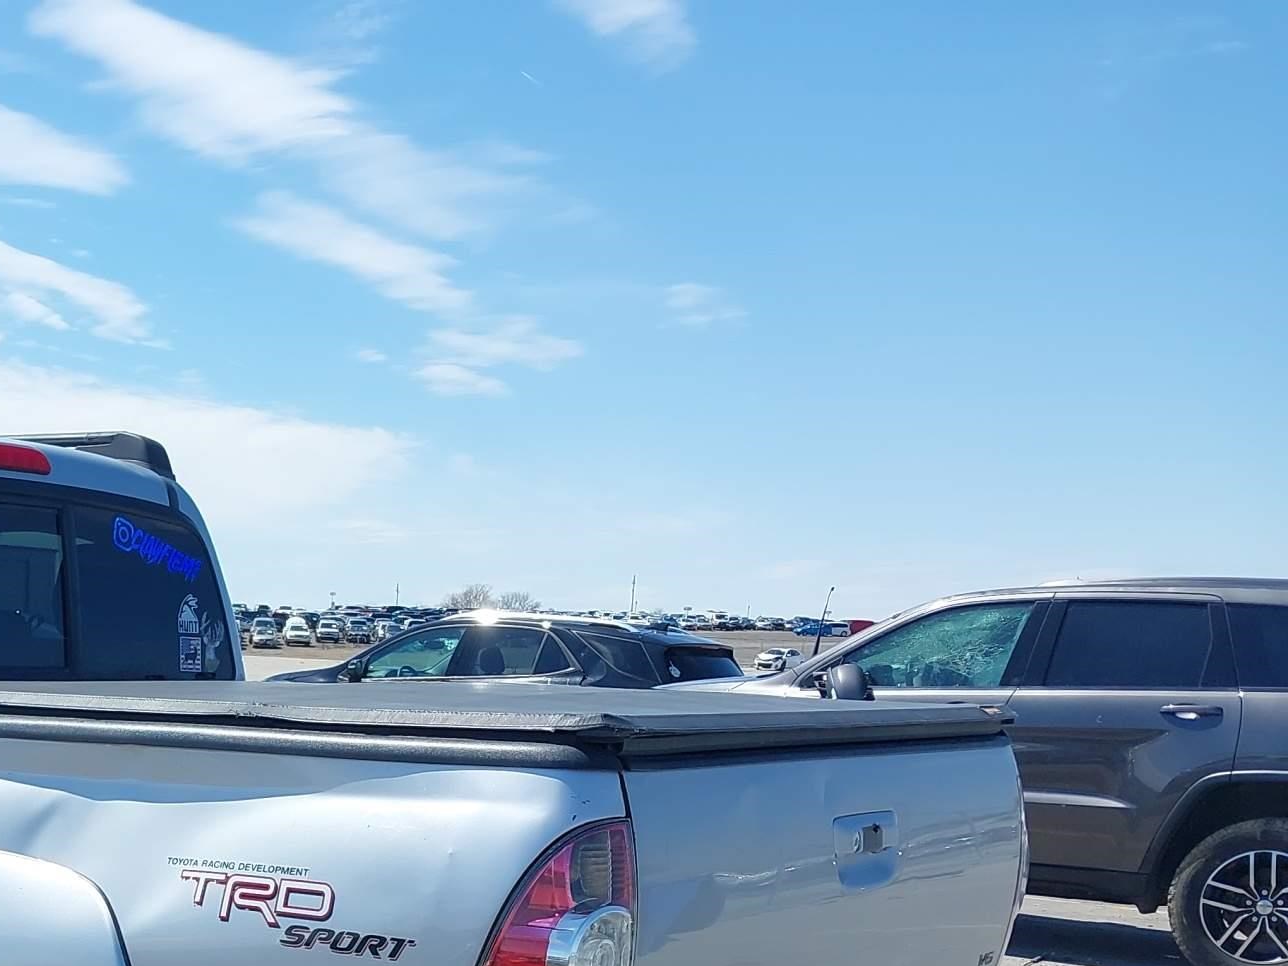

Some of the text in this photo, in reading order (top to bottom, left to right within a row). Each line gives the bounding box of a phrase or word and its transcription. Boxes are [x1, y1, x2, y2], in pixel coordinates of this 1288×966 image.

[178, 619, 200, 633] HUNT
[167, 856, 310, 877] TOYOTA RACING DEVELOPMENT
[181, 869, 336, 929] TRD
[279, 924, 417, 962] SPORT
